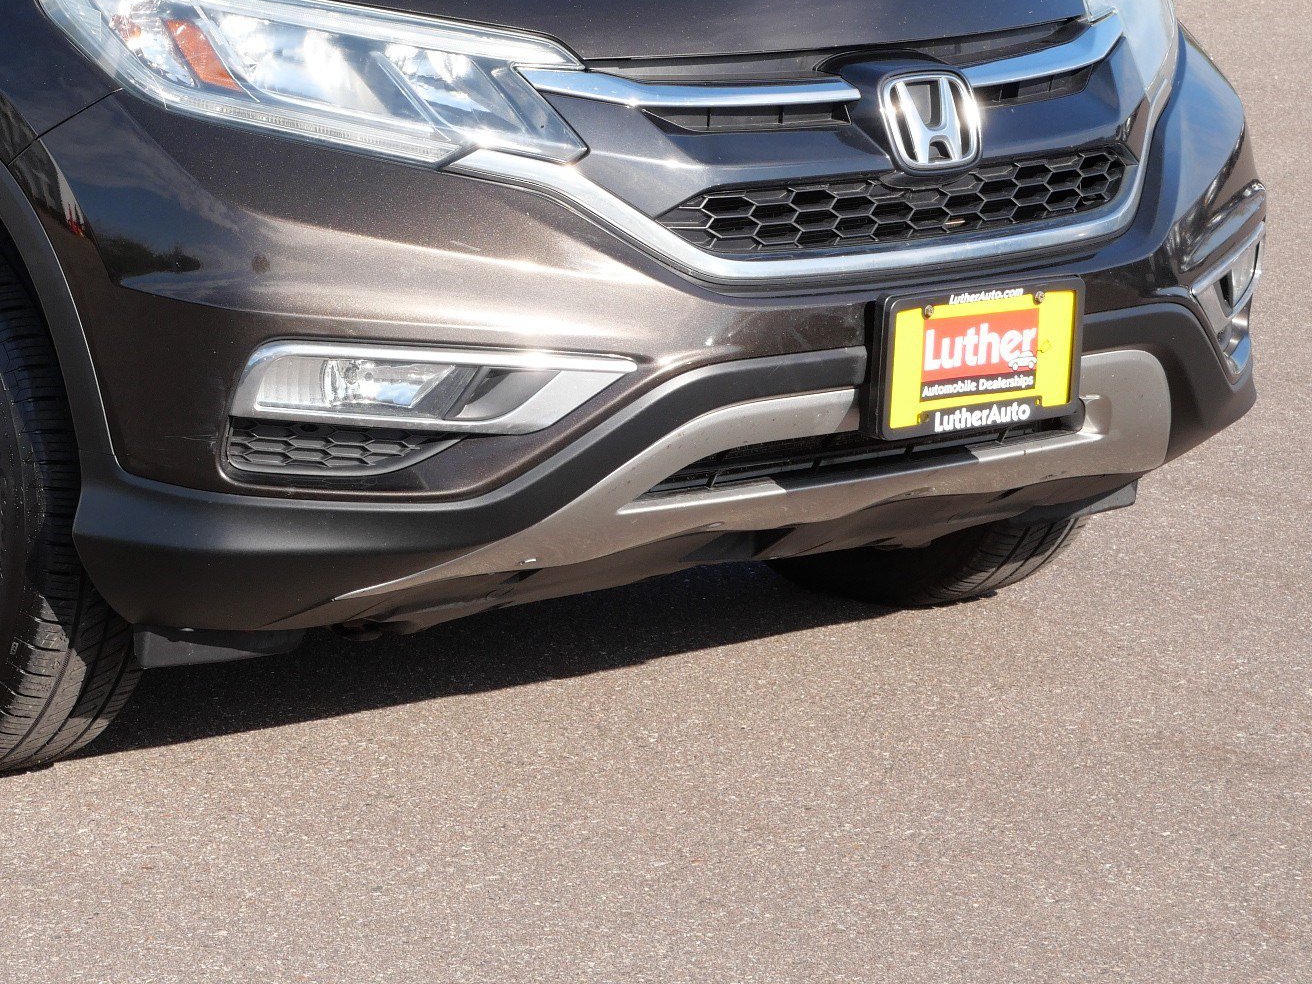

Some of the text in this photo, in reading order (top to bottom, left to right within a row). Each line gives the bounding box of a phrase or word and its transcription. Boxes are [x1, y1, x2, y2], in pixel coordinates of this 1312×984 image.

[948, 288, 1024, 305] LutherAuto.com
[923, 323, 1037, 371] Luther
[922, 375, 1034, 398] Automobile Dealerships
[934, 403, 1031, 433] LutherAuto
